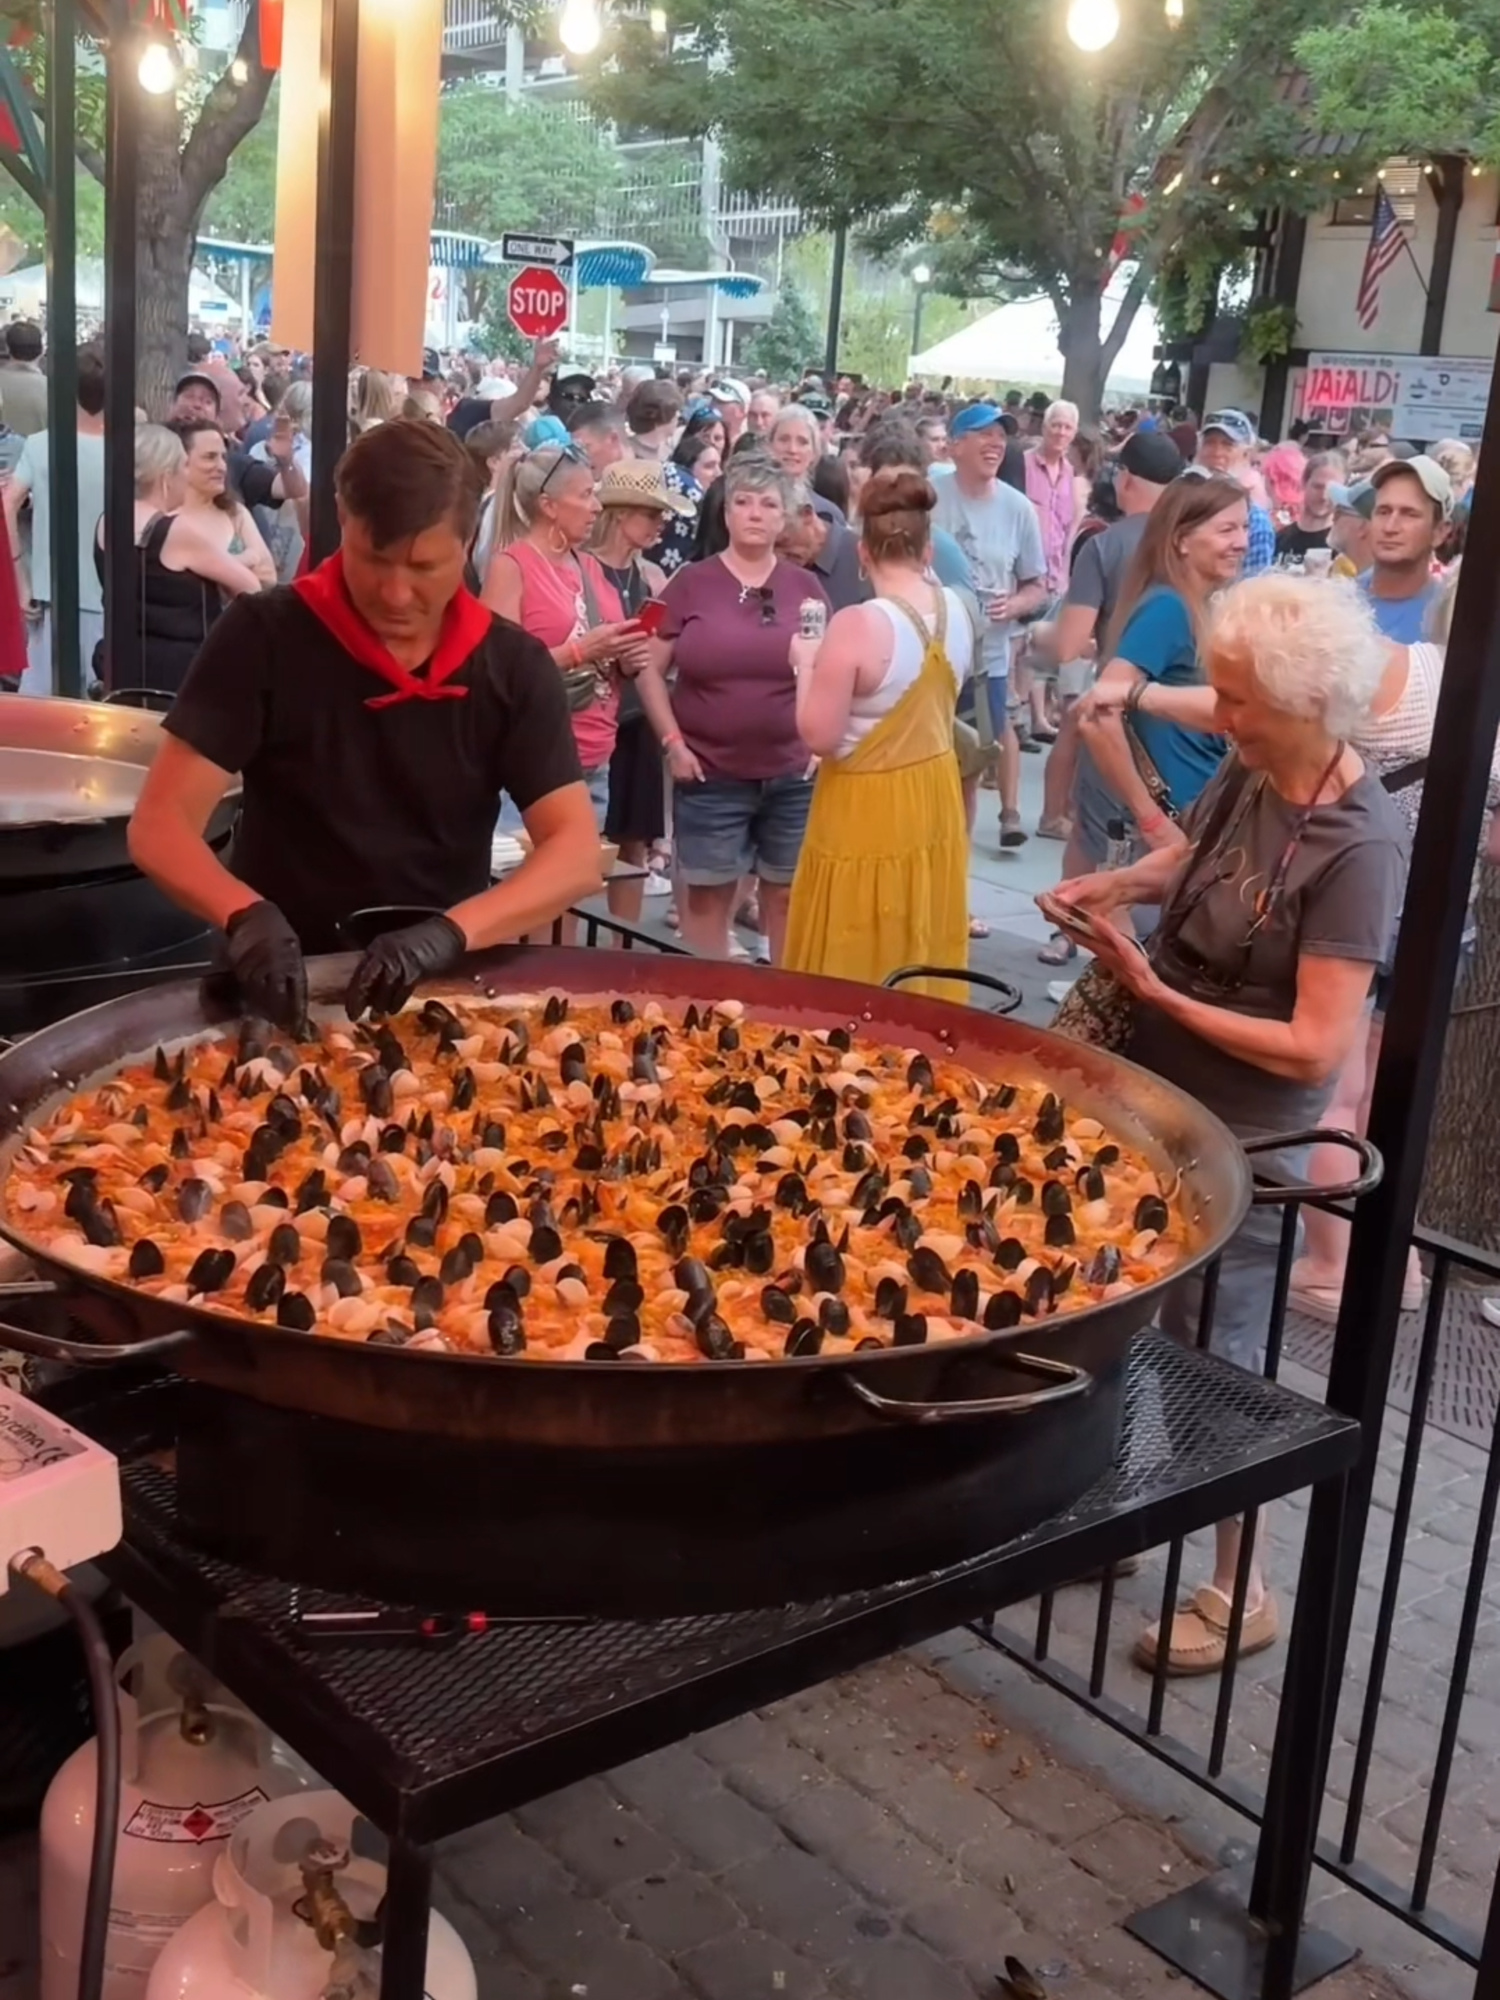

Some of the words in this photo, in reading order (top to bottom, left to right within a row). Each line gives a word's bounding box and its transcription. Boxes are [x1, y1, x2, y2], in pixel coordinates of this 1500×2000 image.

[509, 241, 530, 255] ONE
[534, 244, 553, 256] WAY
[512, 287, 564, 317] STOP
